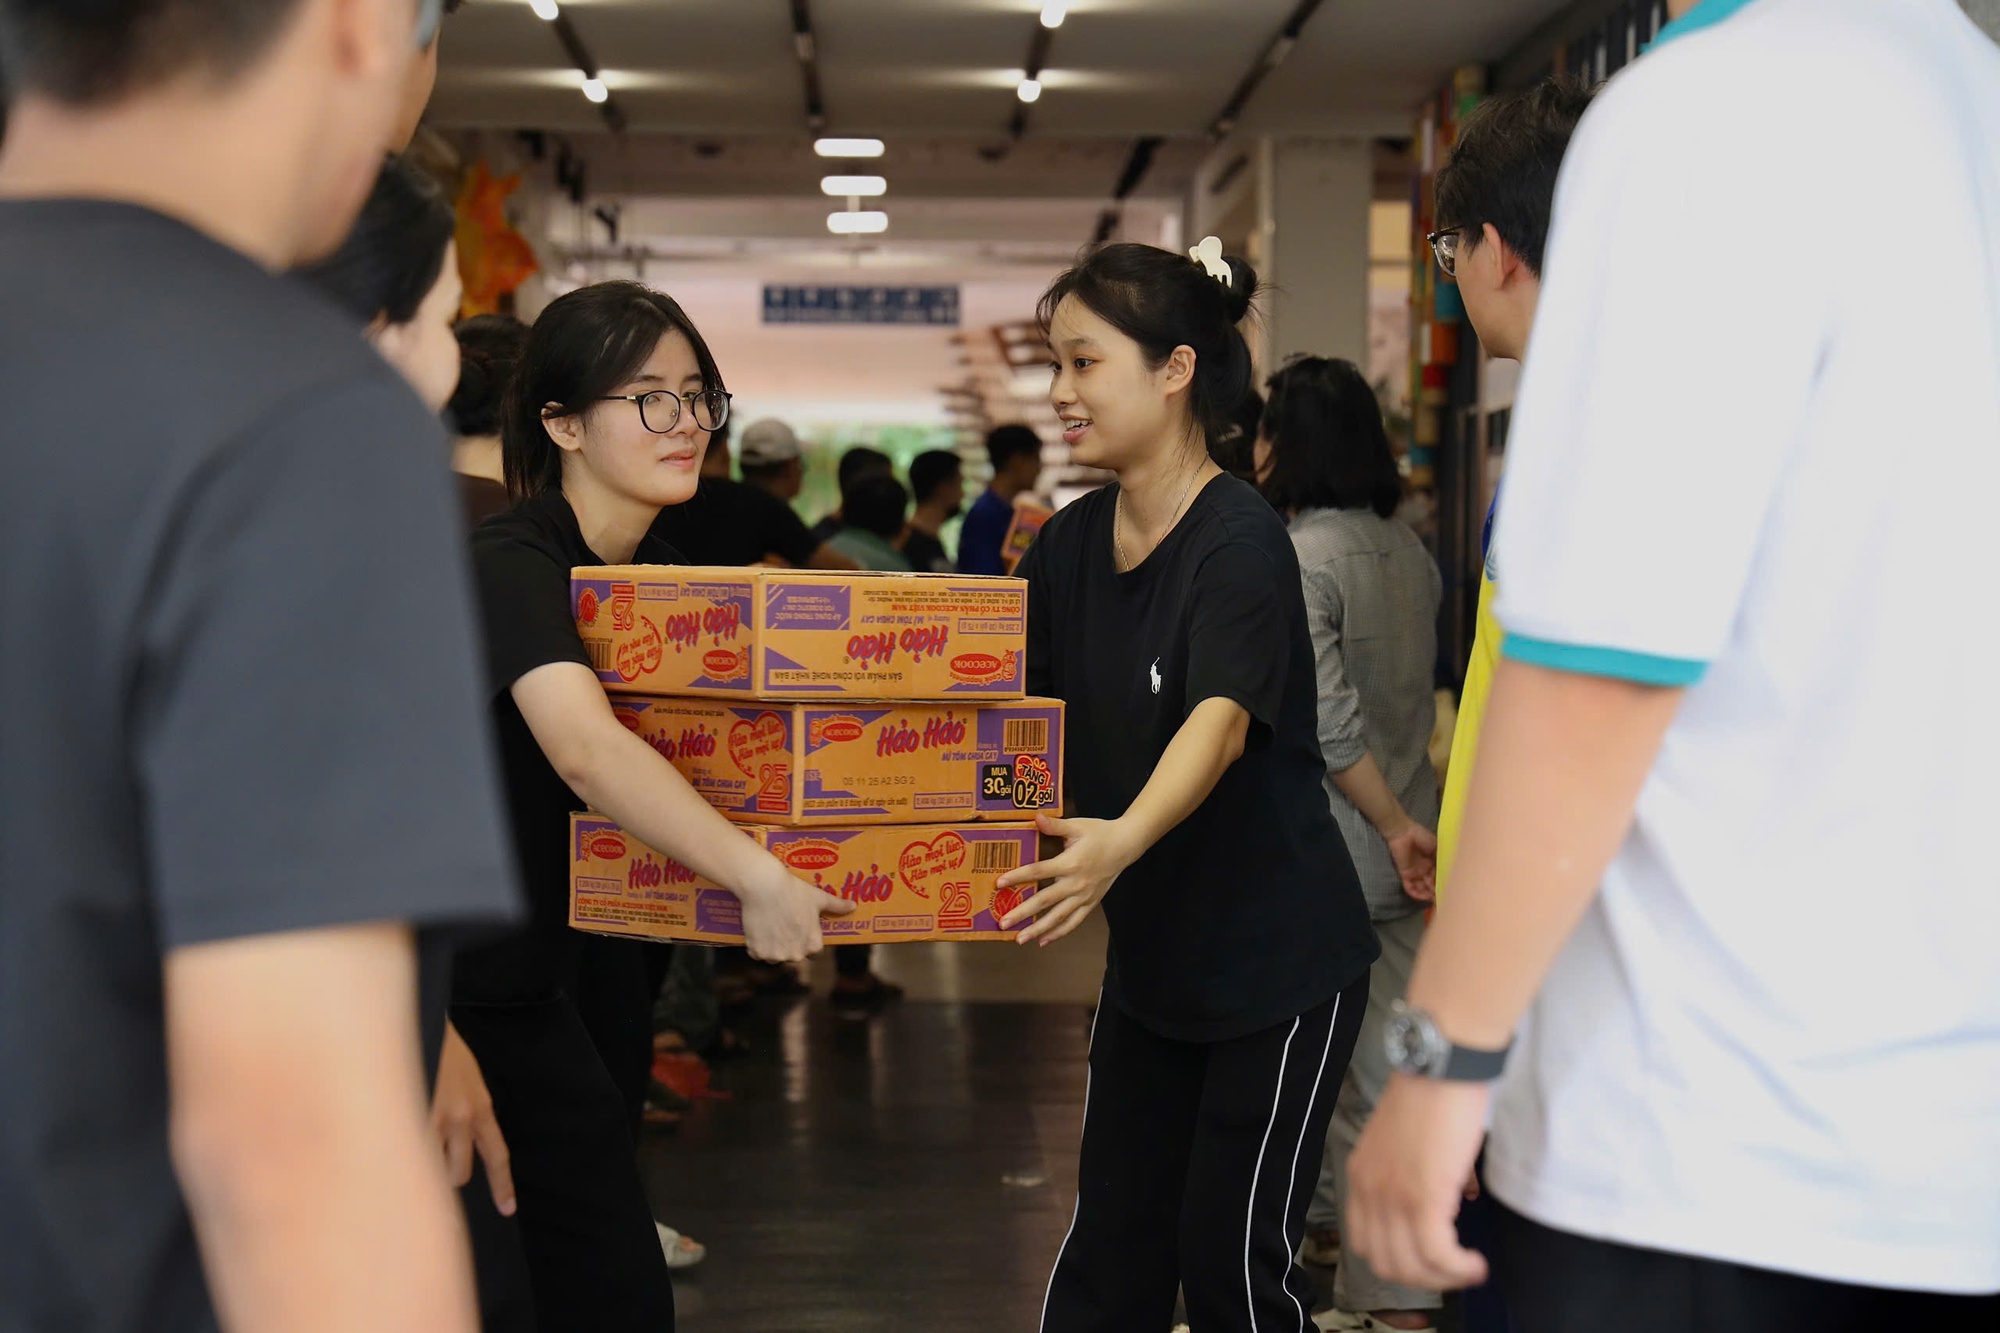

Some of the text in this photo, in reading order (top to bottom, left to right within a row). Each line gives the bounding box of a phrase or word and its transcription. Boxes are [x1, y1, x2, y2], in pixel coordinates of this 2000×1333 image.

[925, 604, 959, 612] ACECOOK
[991, 605, 1001, 613] TY
[1002, 605, 1020, 614] CÔNG
[861, 615, 874, 624] CAY
[665, 603, 740, 654] Hảo Hảo
[846, 625, 948, 670] Hảo Hảo
[812, 671, 830, 681] NGHỆ
[832, 672, 852, 681] CÔNG
[679, 724, 717, 759] Hảo
[876, 711, 966, 757] Hảo Hảo
[953, 751, 966, 761] TÔM
[985, 751, 997, 761] CAY
[991, 767, 1008, 776] MUA
[759, 764, 790, 800] 25
[843, 777, 854, 786] 05
[868, 777, 879, 786] 25
[893, 776, 908, 785] SG
[909, 776, 915, 784] 2
[983, 777, 1012, 797] 30 gói
[1013, 780, 1054, 809] 02 gói
[628, 852, 662, 890] Hảo
[841, 863, 894, 905] Hảo
[938, 882, 972, 917] 25
[855, 921, 870, 930] CAY
